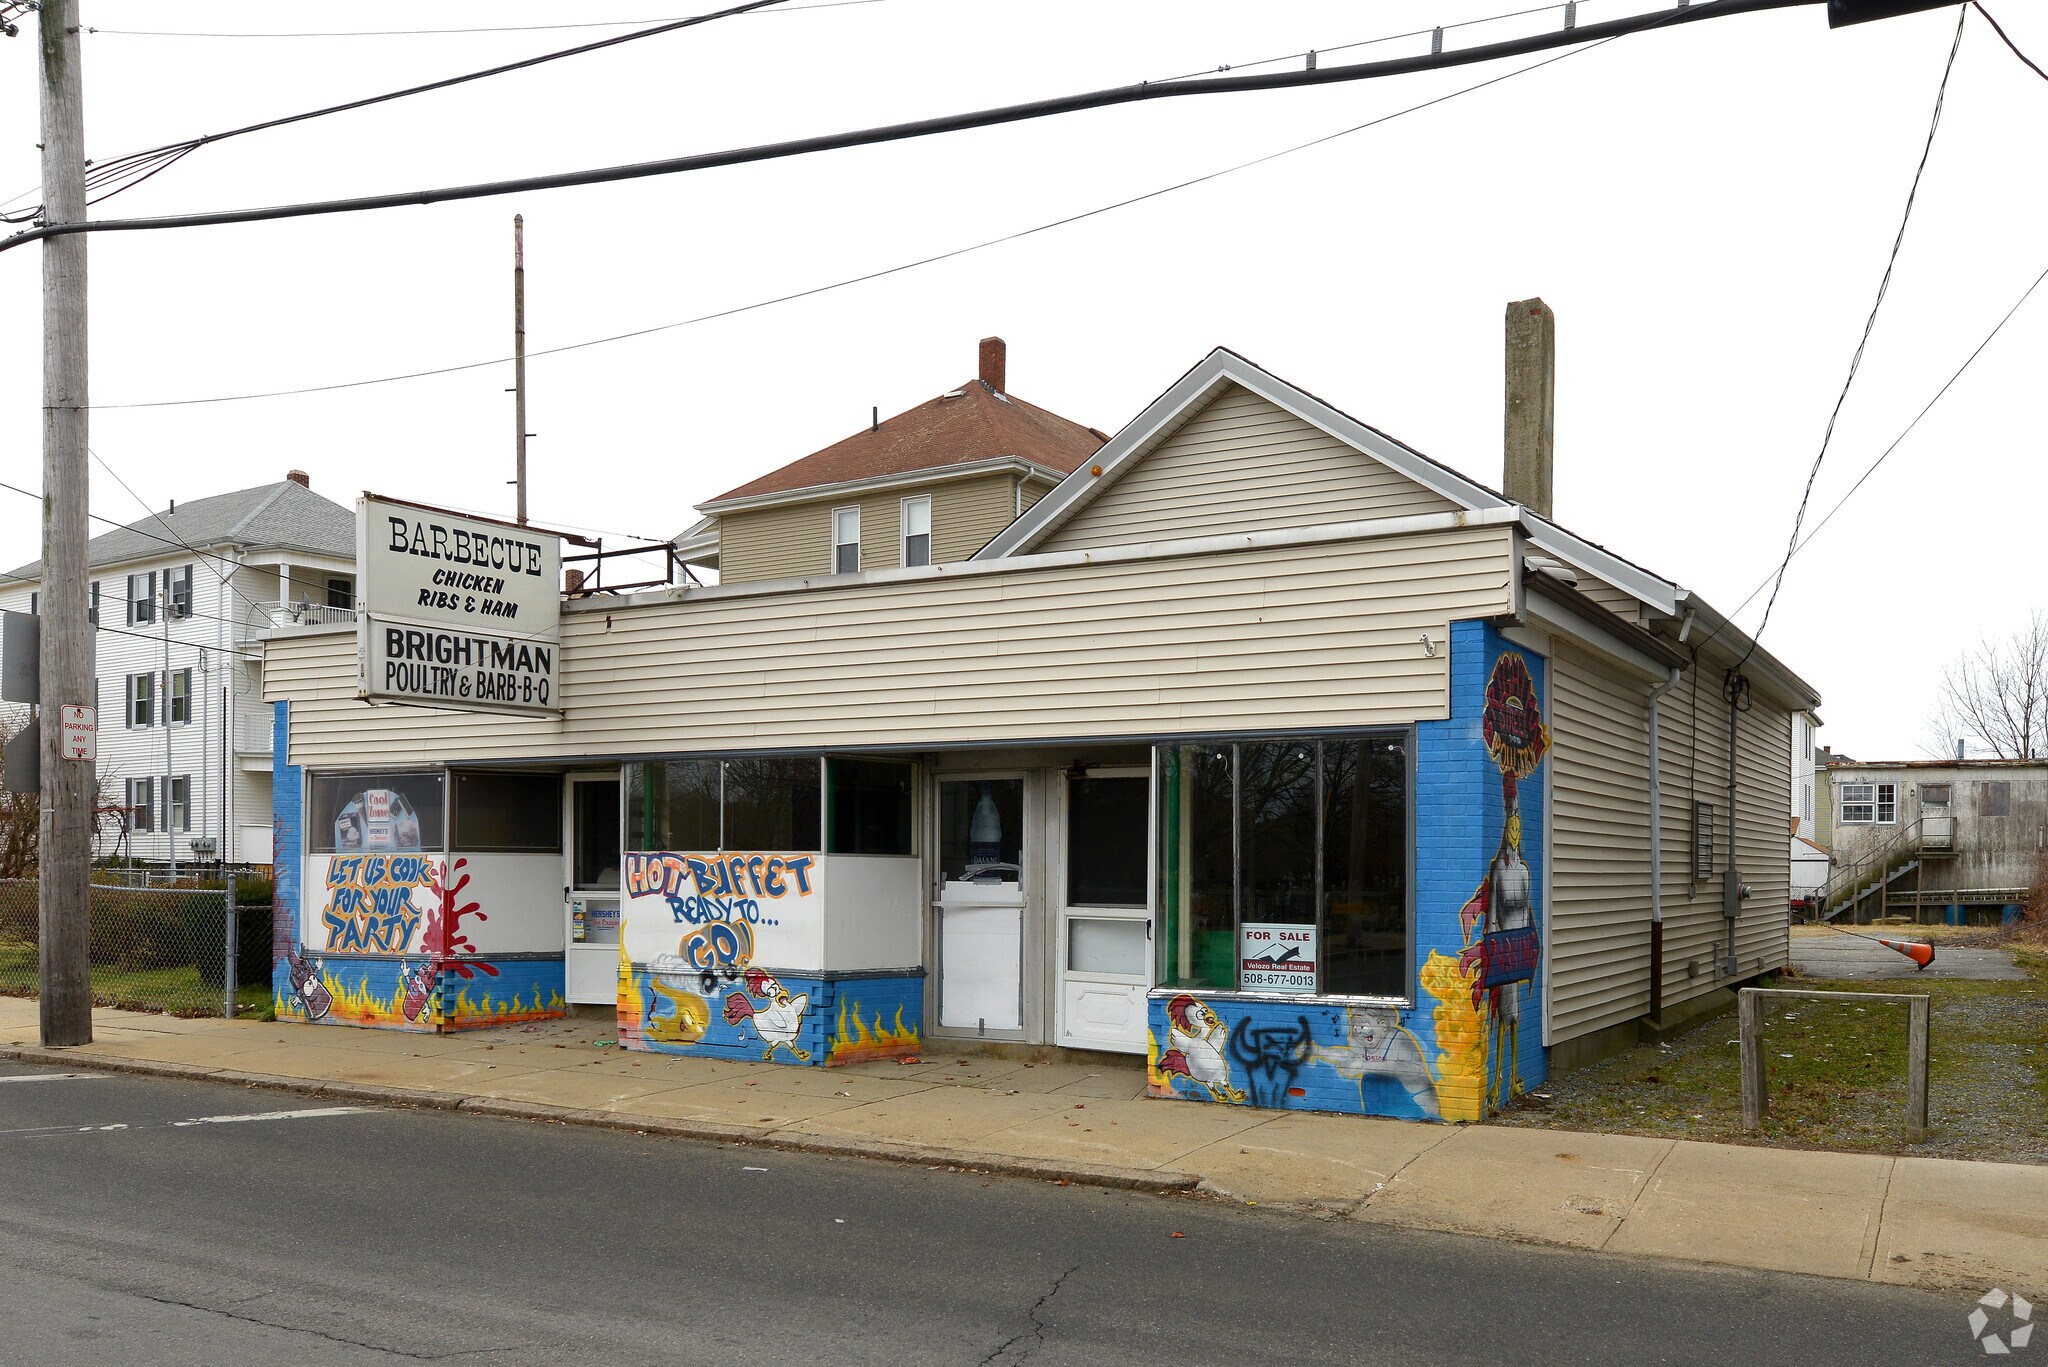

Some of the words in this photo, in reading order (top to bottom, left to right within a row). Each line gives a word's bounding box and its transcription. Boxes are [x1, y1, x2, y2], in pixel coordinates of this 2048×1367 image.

[388, 516, 541, 576] BARBECUE
[432, 568, 505, 594] CHICKEN
[418, 588, 459, 610] RIBS
[464, 596, 475, 613] &
[481, 599, 518, 619] HAM
[386, 628, 551, 674] BRIGHTMAN
[386, 662, 457, 696] POULTRY
[459, 676, 472, 697] &
[476, 671, 549, 706] BARB-B-Q
[65, 723, 93, 731] PARKING
[369, 792, 388, 805] Cool
[369, 806, 388, 818] Zone
[328, 856, 362, 884] LET
[364, 856, 386, 886] US
[390, 856, 432, 883] COOK
[626, 852, 689, 897] HOT
[686, 853, 814, 898] BUFFET
[331, 887, 370, 913] FOR
[369, 886, 421, 916] YOUR
[666, 895, 732, 924] READY
[325, 911, 420, 952] PARTY
[1246, 932, 1270, 940] FOR
[1279, 932, 1310, 941] SALE
[1490, 932, 1538, 976] PARKING
[1244, 974, 1313, 986] 508-677-0013
